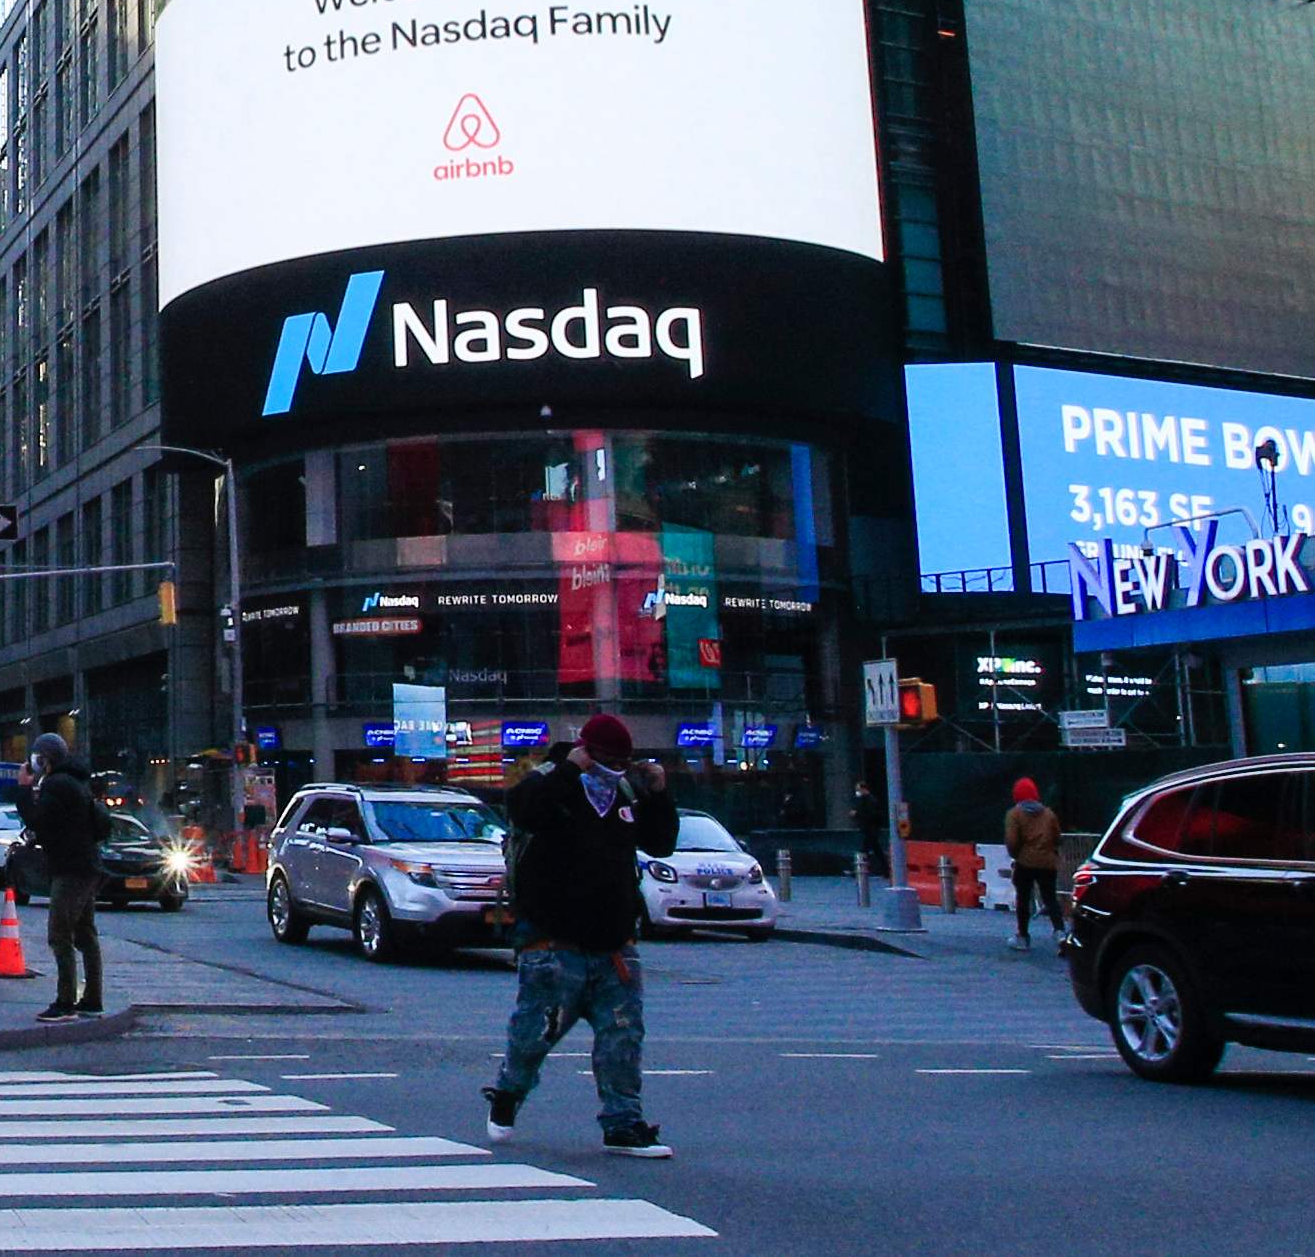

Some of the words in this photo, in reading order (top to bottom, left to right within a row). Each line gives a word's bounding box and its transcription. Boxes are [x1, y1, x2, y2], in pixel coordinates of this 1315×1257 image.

[283, 44, 317, 73] to
[325, 30, 381, 64] the
[391, 10, 539, 51] Nasdaq
[549, 4, 673, 45] Family
[433, 154, 515, 182] airbnb
[392, 287, 705, 380] Nasdaq
[1061, 404, 1212, 466] PRIME
[1069, 484, 1158, 531] 3,163
[1169, 493, 1214, 532] SF
[1069, 538, 1175, 621] NEW
[1172, 520, 1310, 606] YORK
[380, 594, 419, 608] Nasdaq
[438, 593, 487, 605] REWRITE
[492, 593, 558, 605] TOMORROW
[665, 593, 707, 608] Nasdaq
[725, 597, 766, 610] REWRITE
[449, 668, 507, 684] Nasdaq
